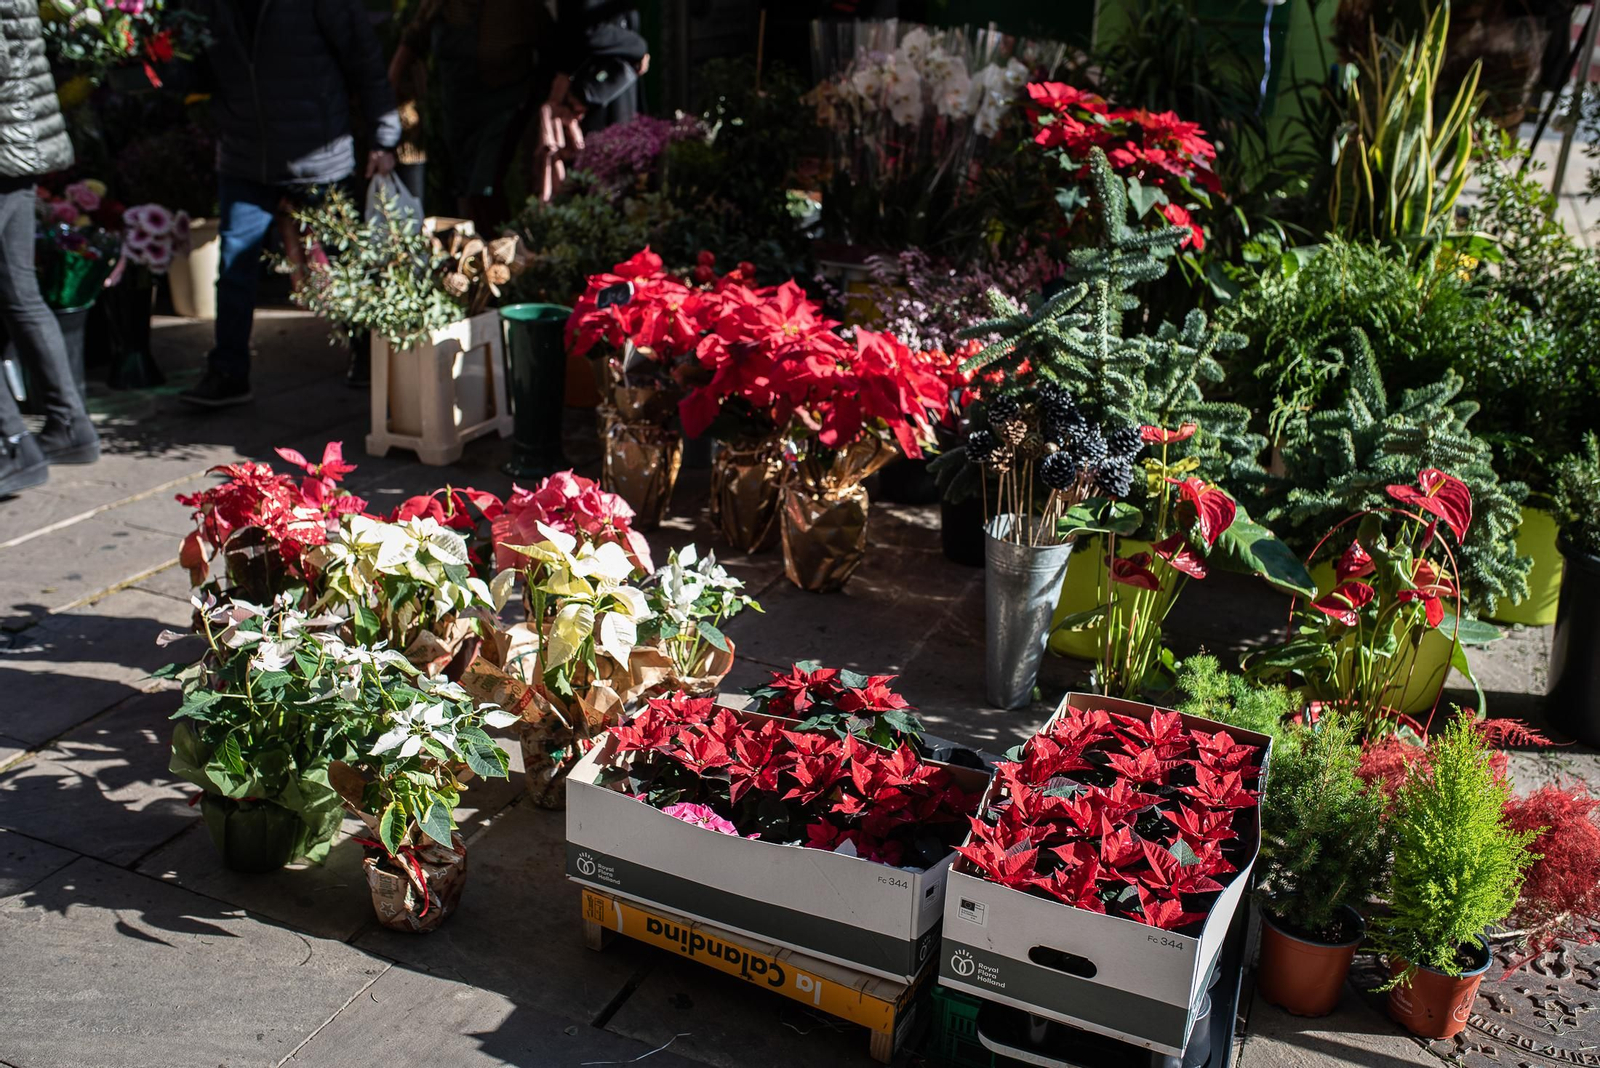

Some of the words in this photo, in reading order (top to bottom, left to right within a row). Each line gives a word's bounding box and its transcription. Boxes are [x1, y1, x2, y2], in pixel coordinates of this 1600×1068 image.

[597, 863, 615, 873] Royal
[597, 868, 613, 878] Flora
[597, 874, 621, 885] Holland
[877, 876, 887, 884] Fc
[888, 877, 908, 889] 344
[1147, 935, 1158, 944] Fc
[1160, 937, 1183, 950] 344
[646, 917, 786, 987] Calandina
[977, 969, 997, 979] Flora
[978, 962, 999, 974] Royal
[976, 975, 1006, 988] Holland
[795, 973, 823, 1006] la
[1506, 1033, 1535, 1051] DE
